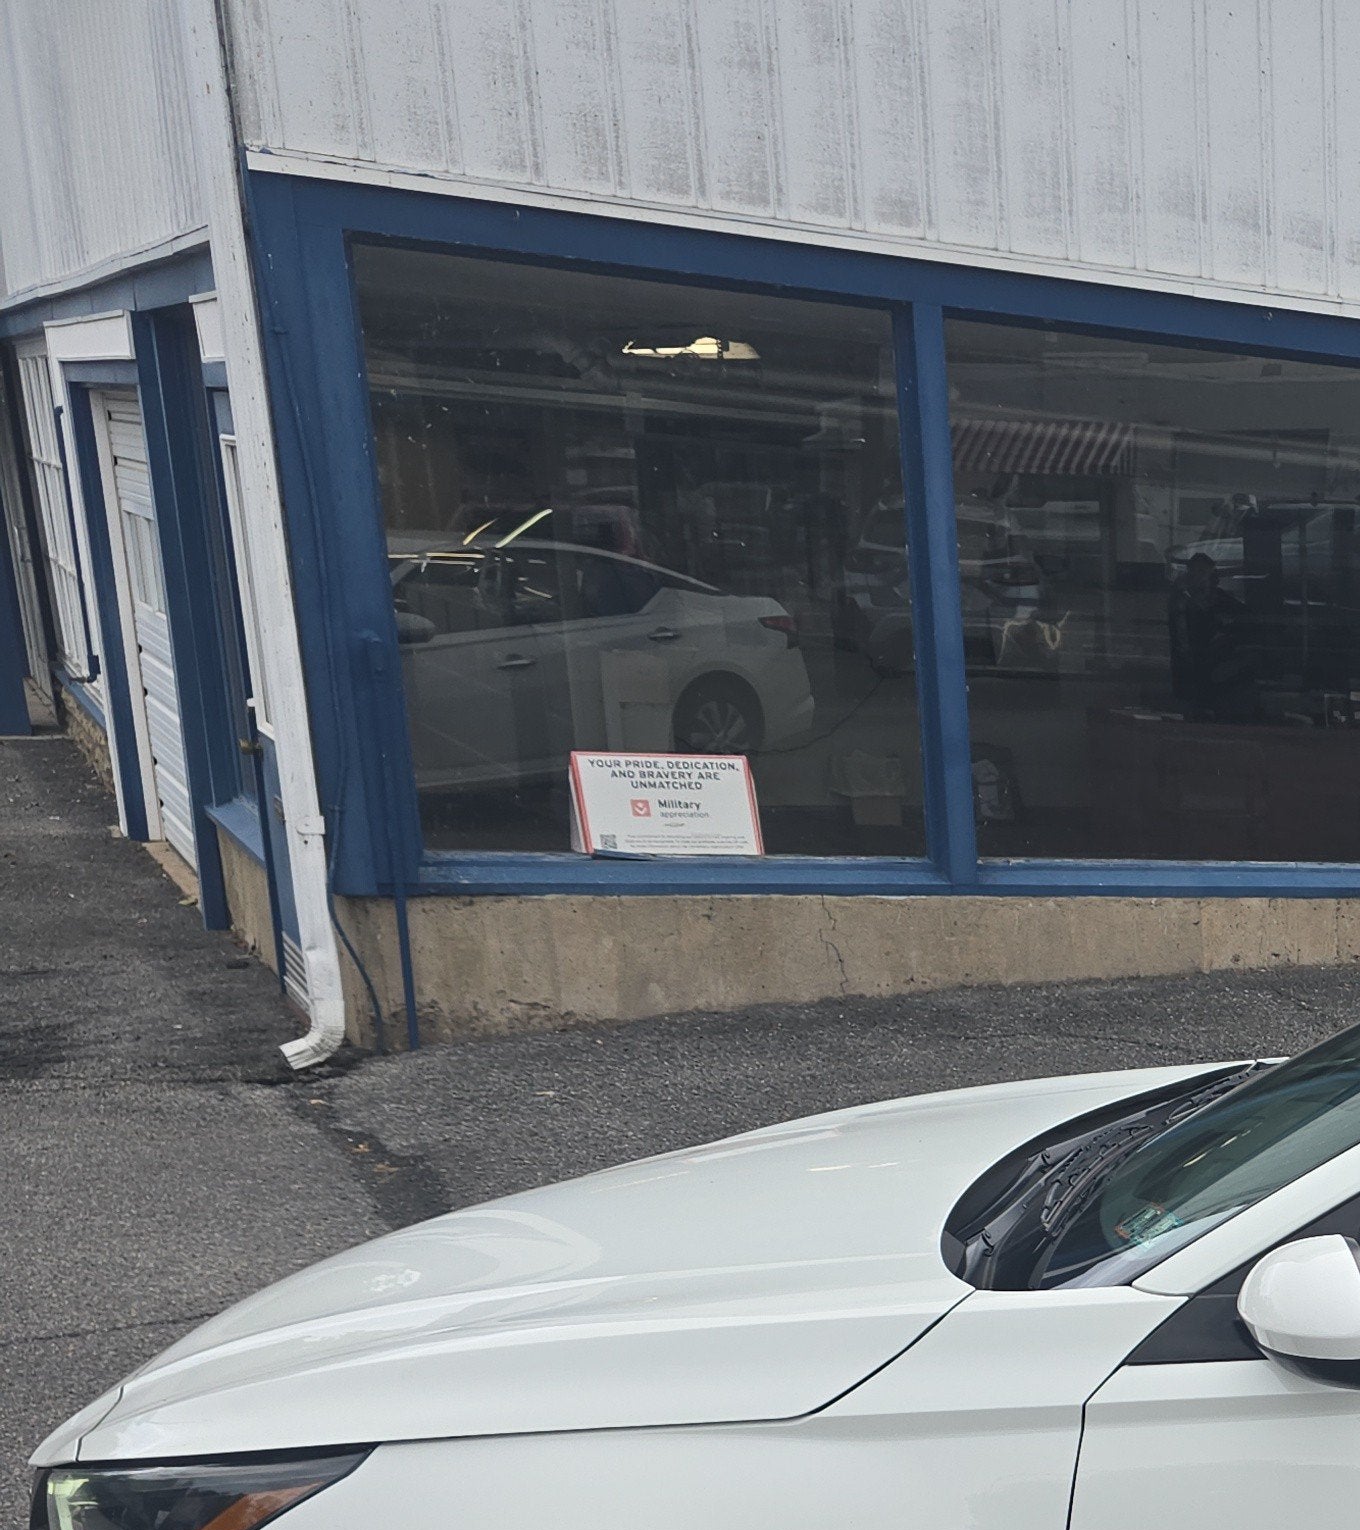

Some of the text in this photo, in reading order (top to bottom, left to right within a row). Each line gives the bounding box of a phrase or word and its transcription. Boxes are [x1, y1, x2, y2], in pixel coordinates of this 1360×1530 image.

[588, 759, 621, 769] YOUR
[667, 761, 740, 772] DEDICATION,
[610, 770, 721, 781] AND BRAVERY ARE
[631, 781, 702, 791] UNMATCHED
[658, 800, 702, 811] Military
[660, 811, 709, 819] appreciation
